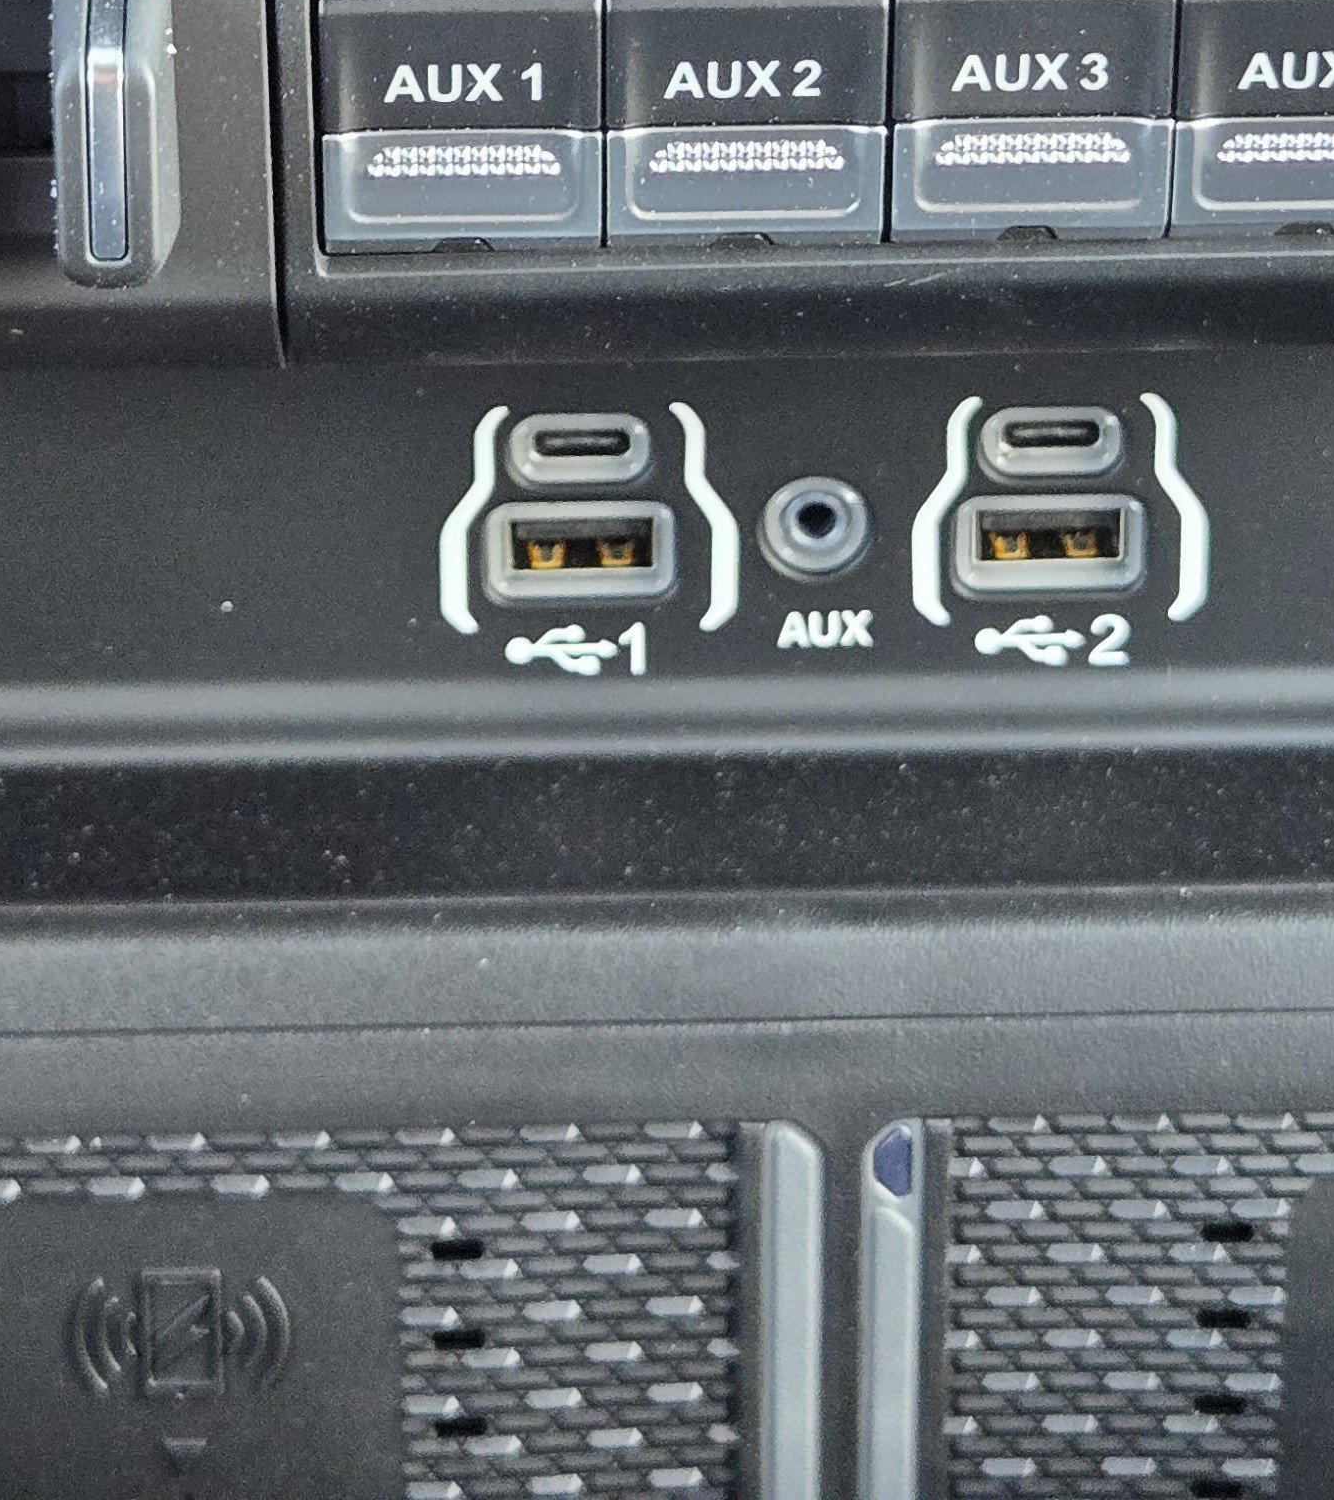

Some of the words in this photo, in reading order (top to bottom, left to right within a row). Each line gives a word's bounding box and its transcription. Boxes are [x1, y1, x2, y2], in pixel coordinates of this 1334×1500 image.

[383, 63, 503, 104] AUX
[521, 62, 543, 102] 1
[662, 59, 781, 100] AUX
[791, 59, 822, 97] 2
[951, 52, 1070, 92] AUX
[1079, 52, 1109, 91] 3
[618, 621, 646, 676] 1
[776, 609, 874, 649] AUX
[1087, 613, 1131, 667] 2
